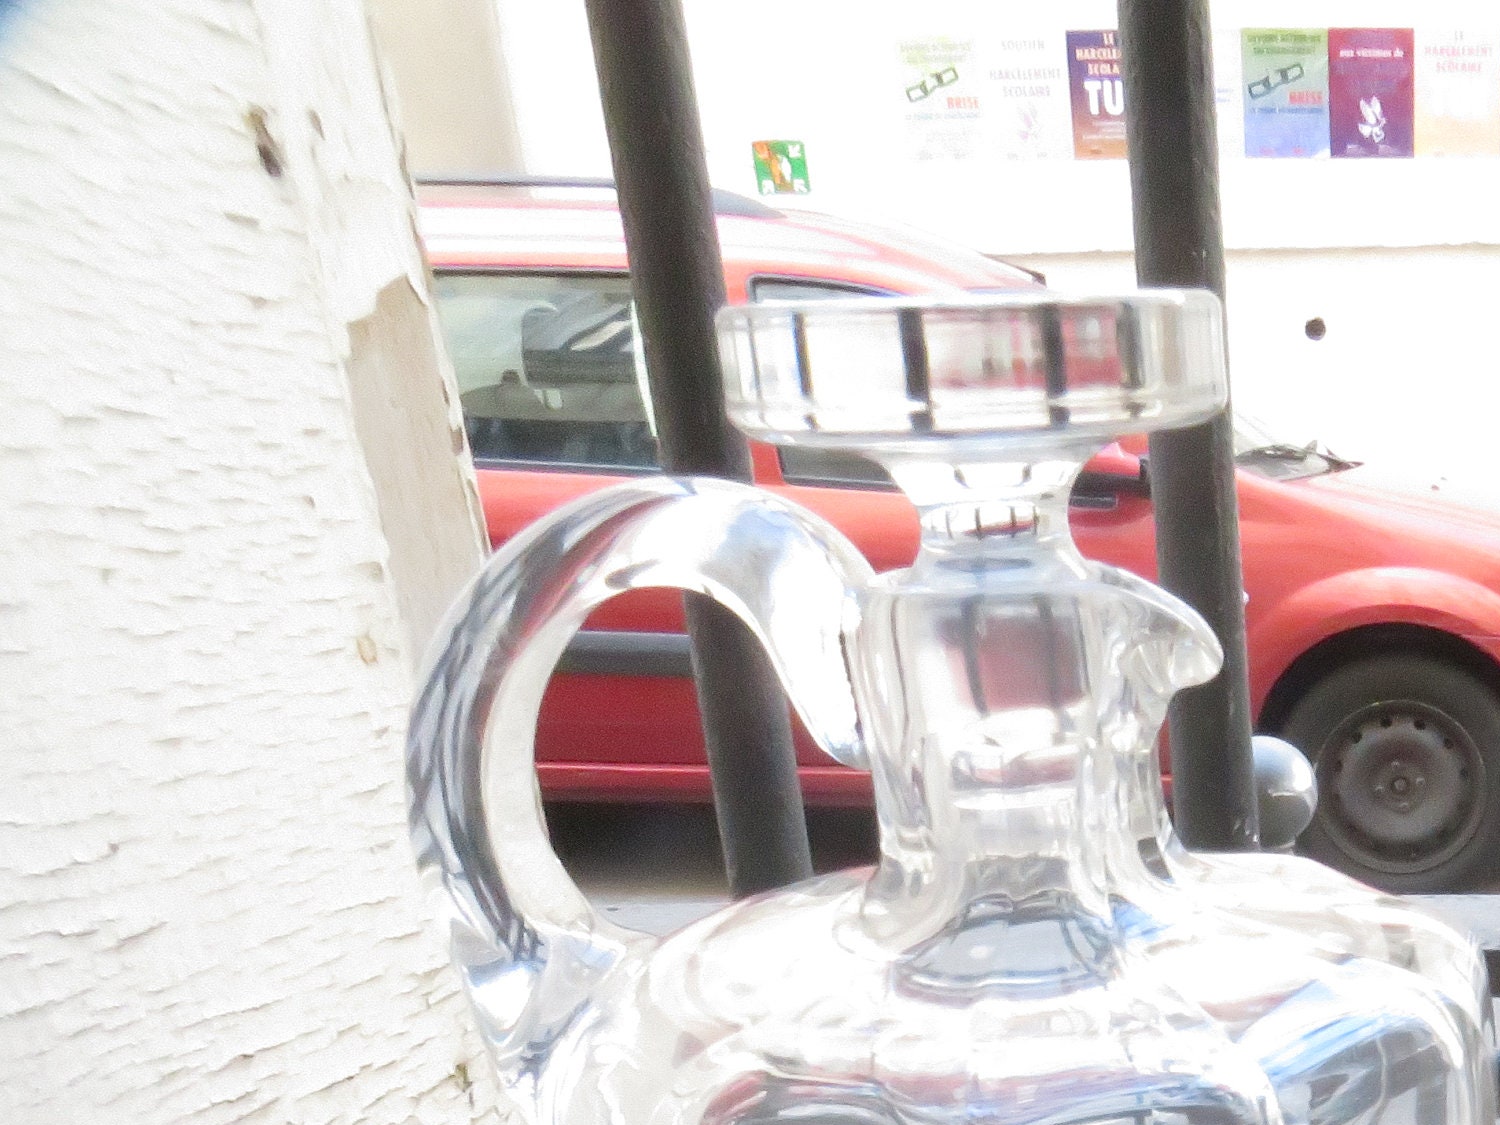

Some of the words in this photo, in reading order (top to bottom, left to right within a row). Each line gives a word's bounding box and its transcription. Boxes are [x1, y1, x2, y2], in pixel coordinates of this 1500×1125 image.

[1103, 33, 1114, 45] LE
[1088, 63, 1120, 75] SCOLA
[947, 97, 979, 109] BRISE
[1084, 80, 1124, 115] TU
